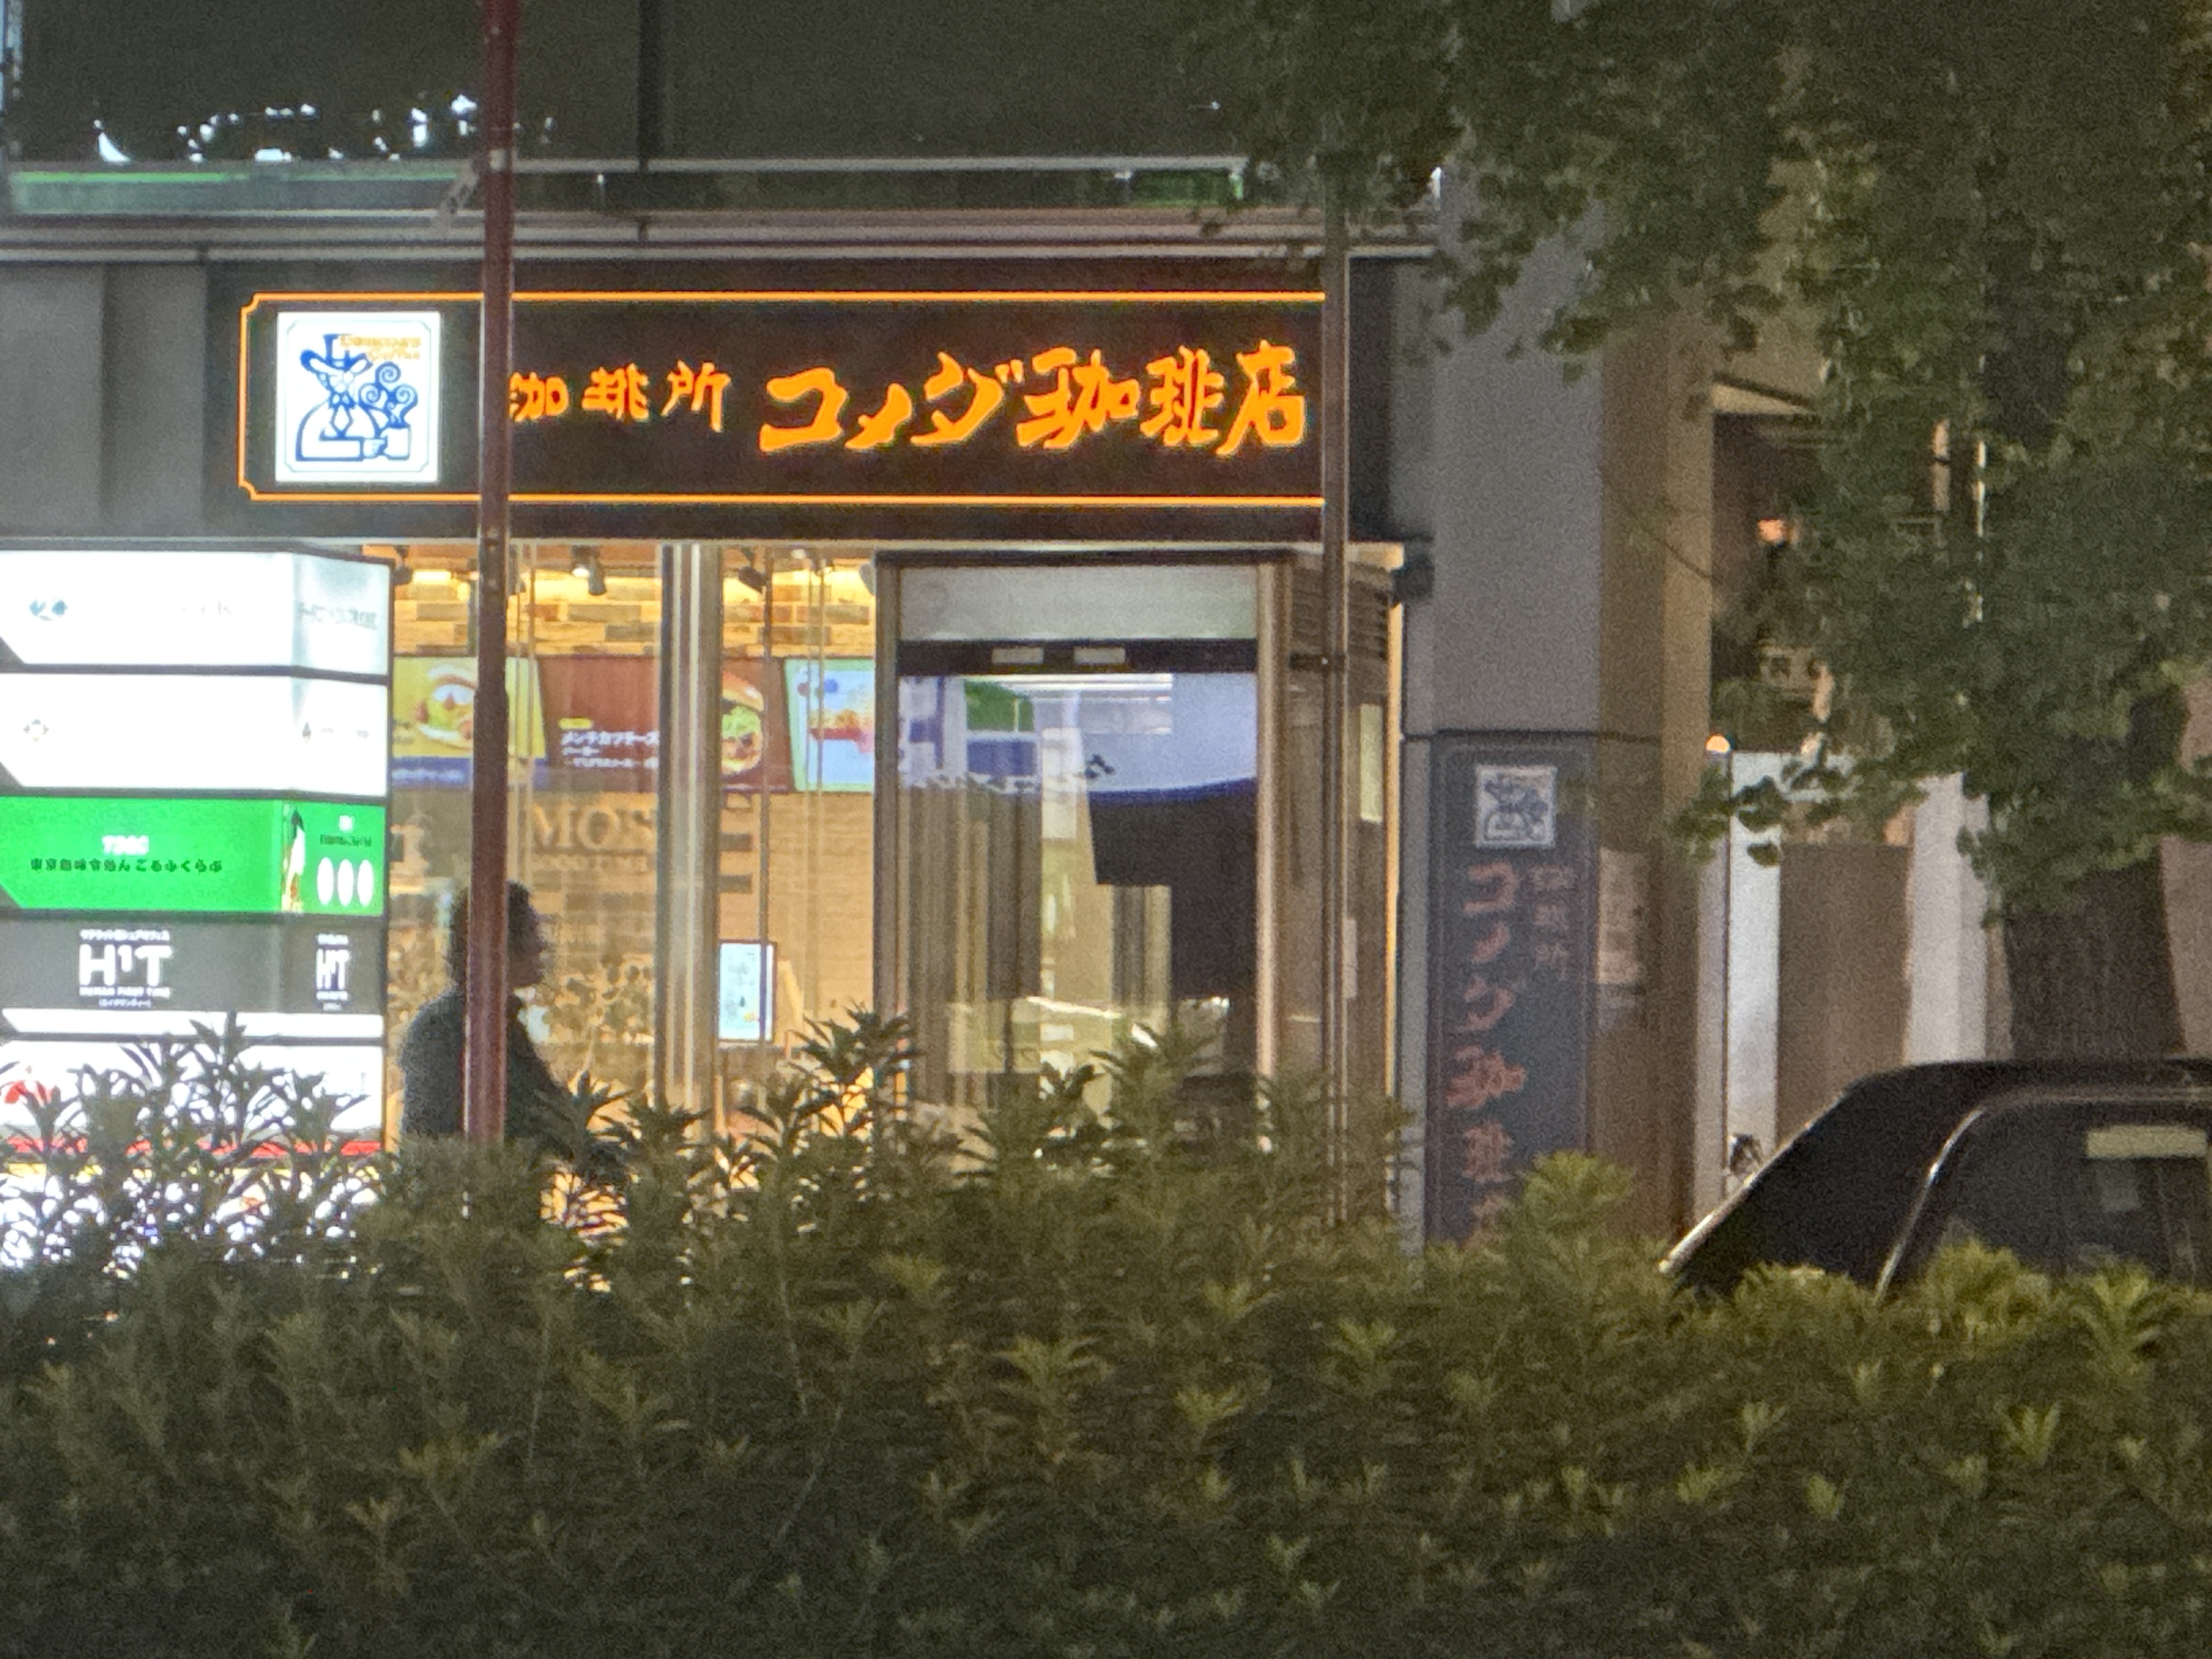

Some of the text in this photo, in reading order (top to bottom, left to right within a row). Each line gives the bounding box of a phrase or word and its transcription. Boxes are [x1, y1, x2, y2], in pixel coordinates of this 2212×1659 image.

[759, 339, 1306, 455] コメダ珈琲店
